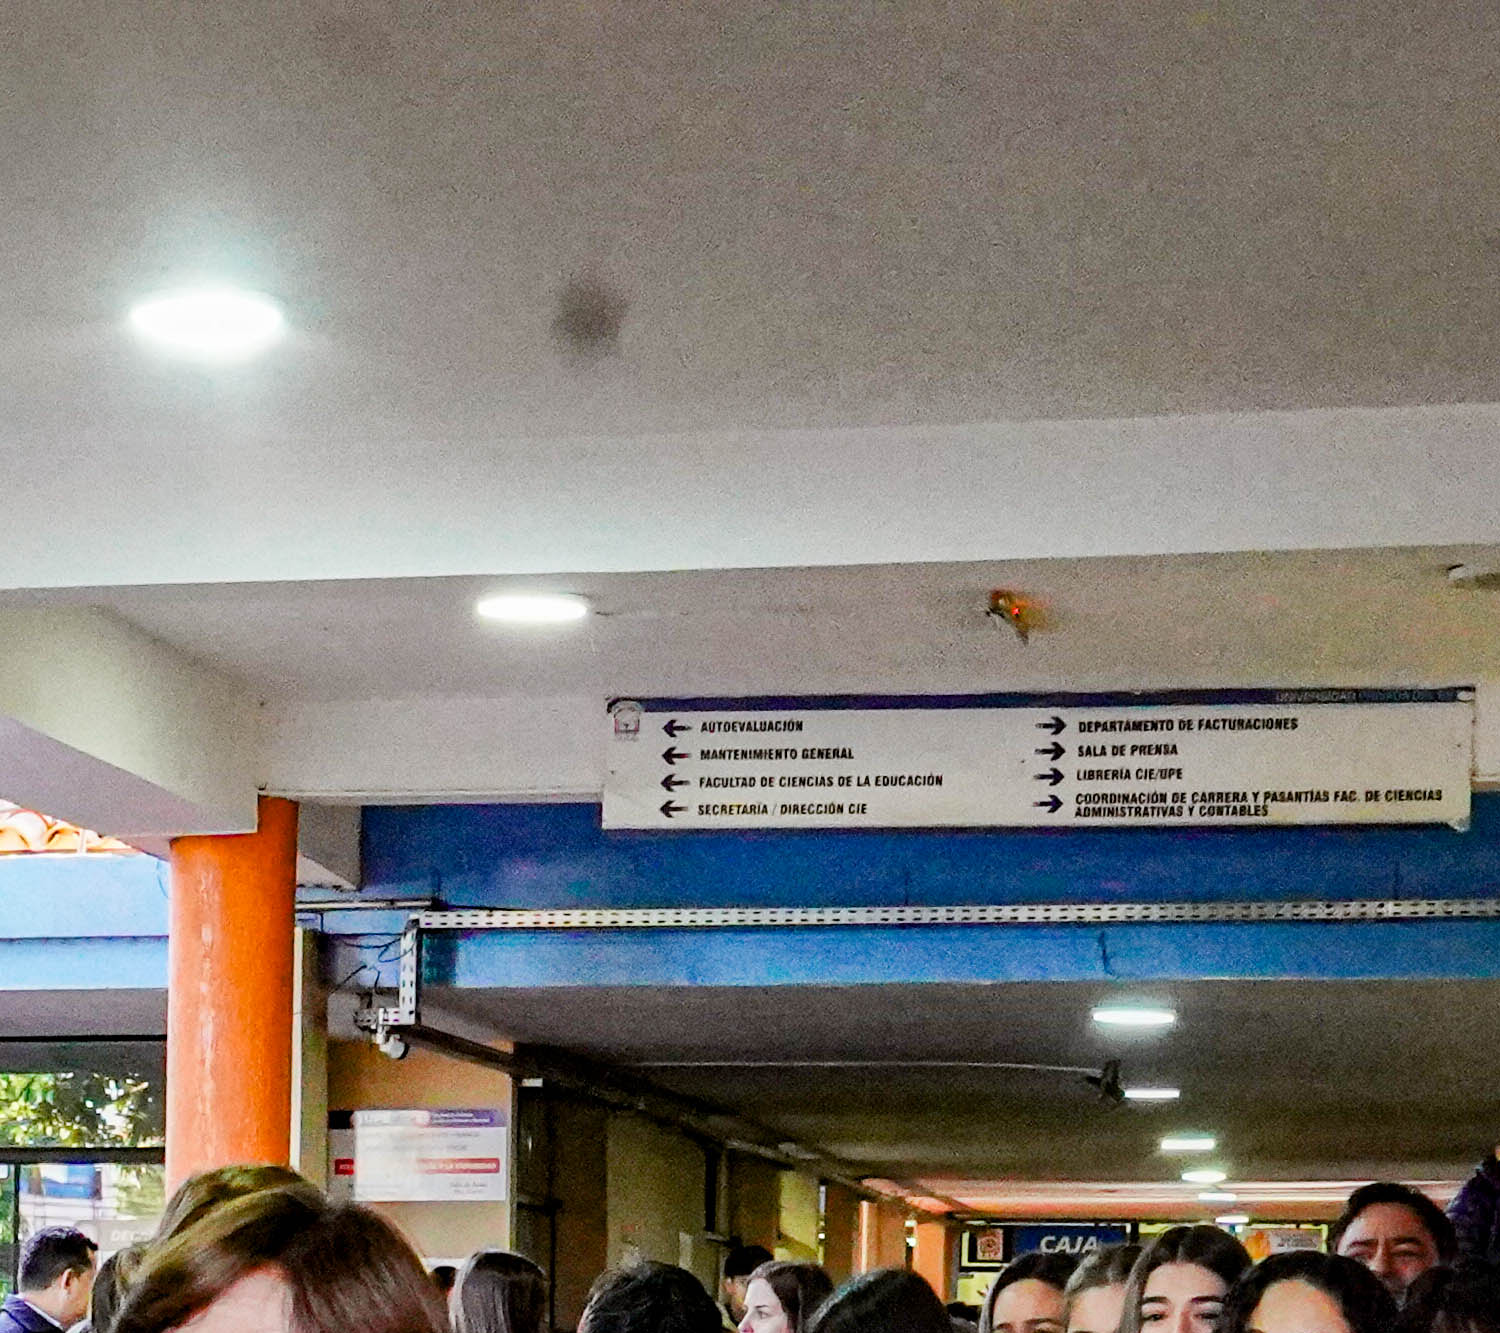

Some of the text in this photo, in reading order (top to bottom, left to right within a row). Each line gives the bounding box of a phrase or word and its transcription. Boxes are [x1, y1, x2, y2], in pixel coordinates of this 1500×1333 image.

[700, 719, 804, 733] AUTOEVALUACIÓN
[1078, 716, 1299, 733] DEPARTAMENTO DE FACTURACIONES
[700, 747, 855, 761] MANTENIMIENTO GENERAL
[1077, 743, 1179, 758] SALA DE PRENSA
[699, 772, 944, 789] FACULTAD DE CIENCIAS DE LA EDUCACIÓN
[1075, 790, 1168, 806] COORDINACIÓN
[1171, 791, 1188, 805] DE
[1190, 791, 1250, 805] CARRERA
[1252, 791, 1260, 804] Y
[1263, 788, 1330, 804] PASANTÍAS
[1364, 789, 1381, 802] DE
[1384, 788, 1443, 802] CIENCIAS
[780, 801, 845, 816] DIRECCIÓN
[847, 802, 868, 816] CIE
[1074, 803, 1269, 818] ADMINISTRATIVAS Y CONTABLES
[1039, 1234, 1099, 1254] CAJA
